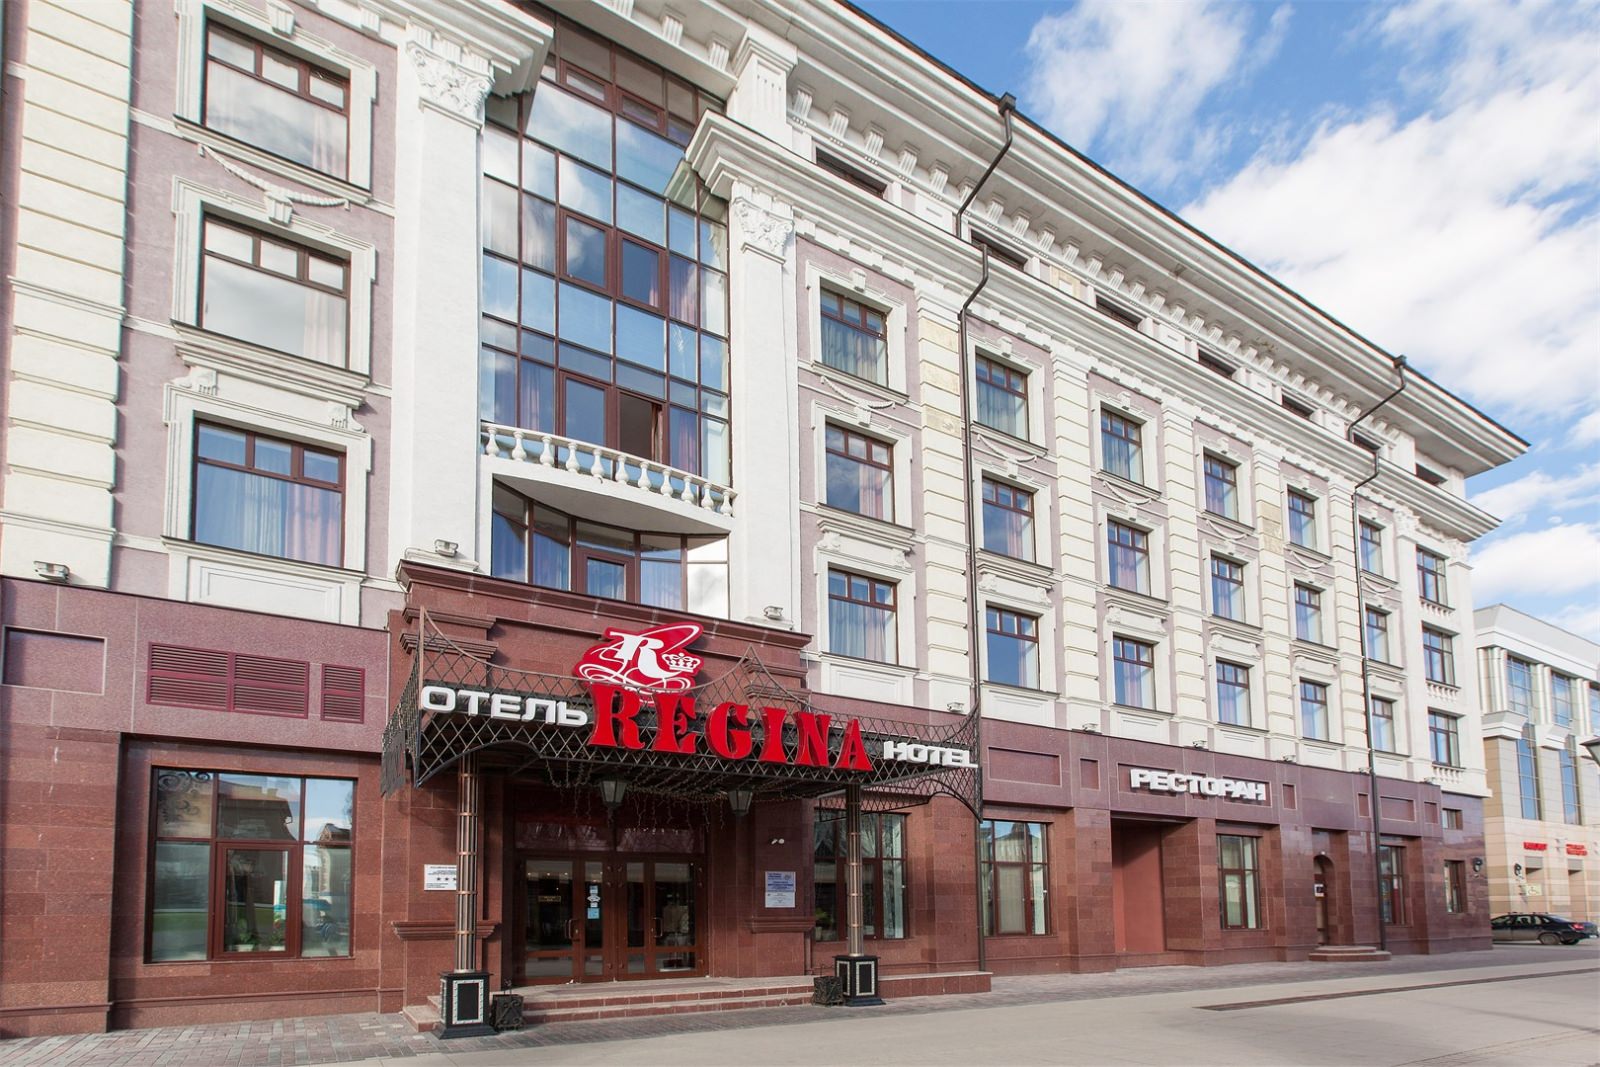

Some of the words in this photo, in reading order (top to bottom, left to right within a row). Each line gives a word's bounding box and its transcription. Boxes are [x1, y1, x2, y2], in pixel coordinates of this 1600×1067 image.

[421, 685, 588, 727] ОТЕЛЬ
[588, 682, 873, 771] REGINA
[883, 741, 978, 768] HOTEL
[1130, 768, 1266, 801] РЕСТОРАН
